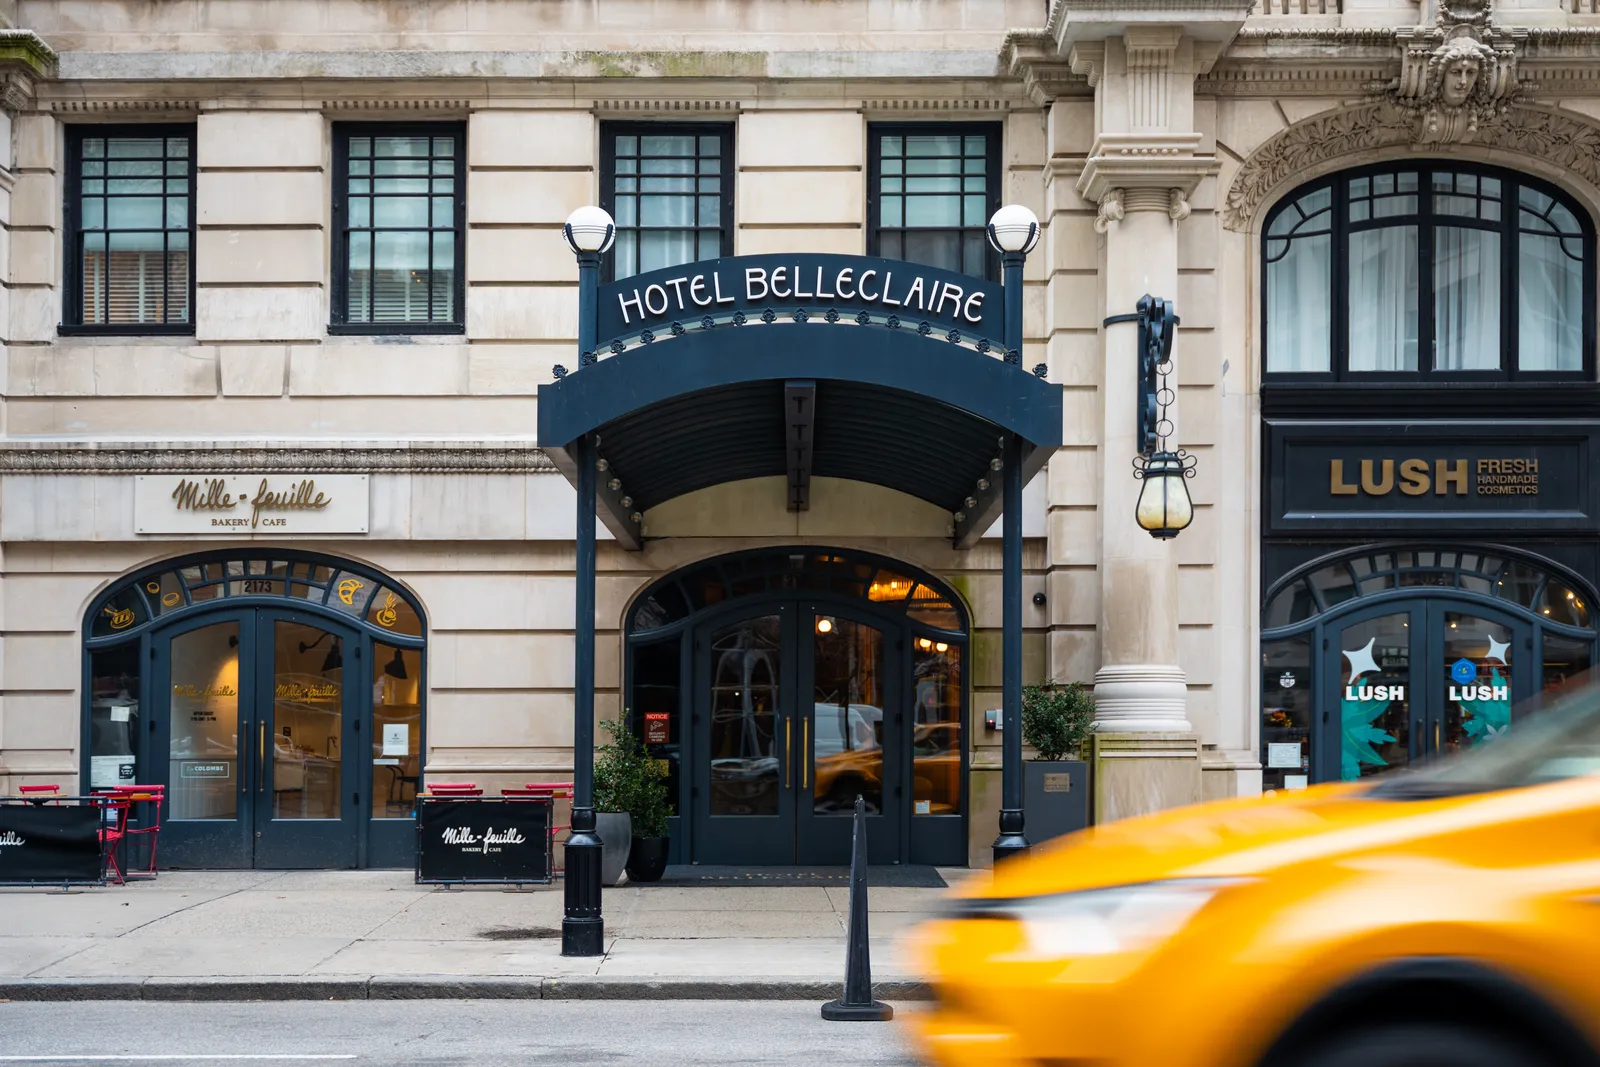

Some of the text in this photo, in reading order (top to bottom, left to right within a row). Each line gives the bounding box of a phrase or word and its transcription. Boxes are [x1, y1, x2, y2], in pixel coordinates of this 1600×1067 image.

[618, 266, 985, 324] HOTEL BELLECLAIRE
[1476, 458, 1539, 474] FRESH
[1330, 458, 1469, 496] LUSH
[1476, 474, 1539, 484] HANDMADE
[1476, 484, 1539, 495] COSMETICS
[211, 518, 287, 526] BAKERY CAFE
[244, 580, 272, 593] 2173
[1345, 685, 1405, 701] LUSH
[1449, 685, 1508, 701] LUSH
